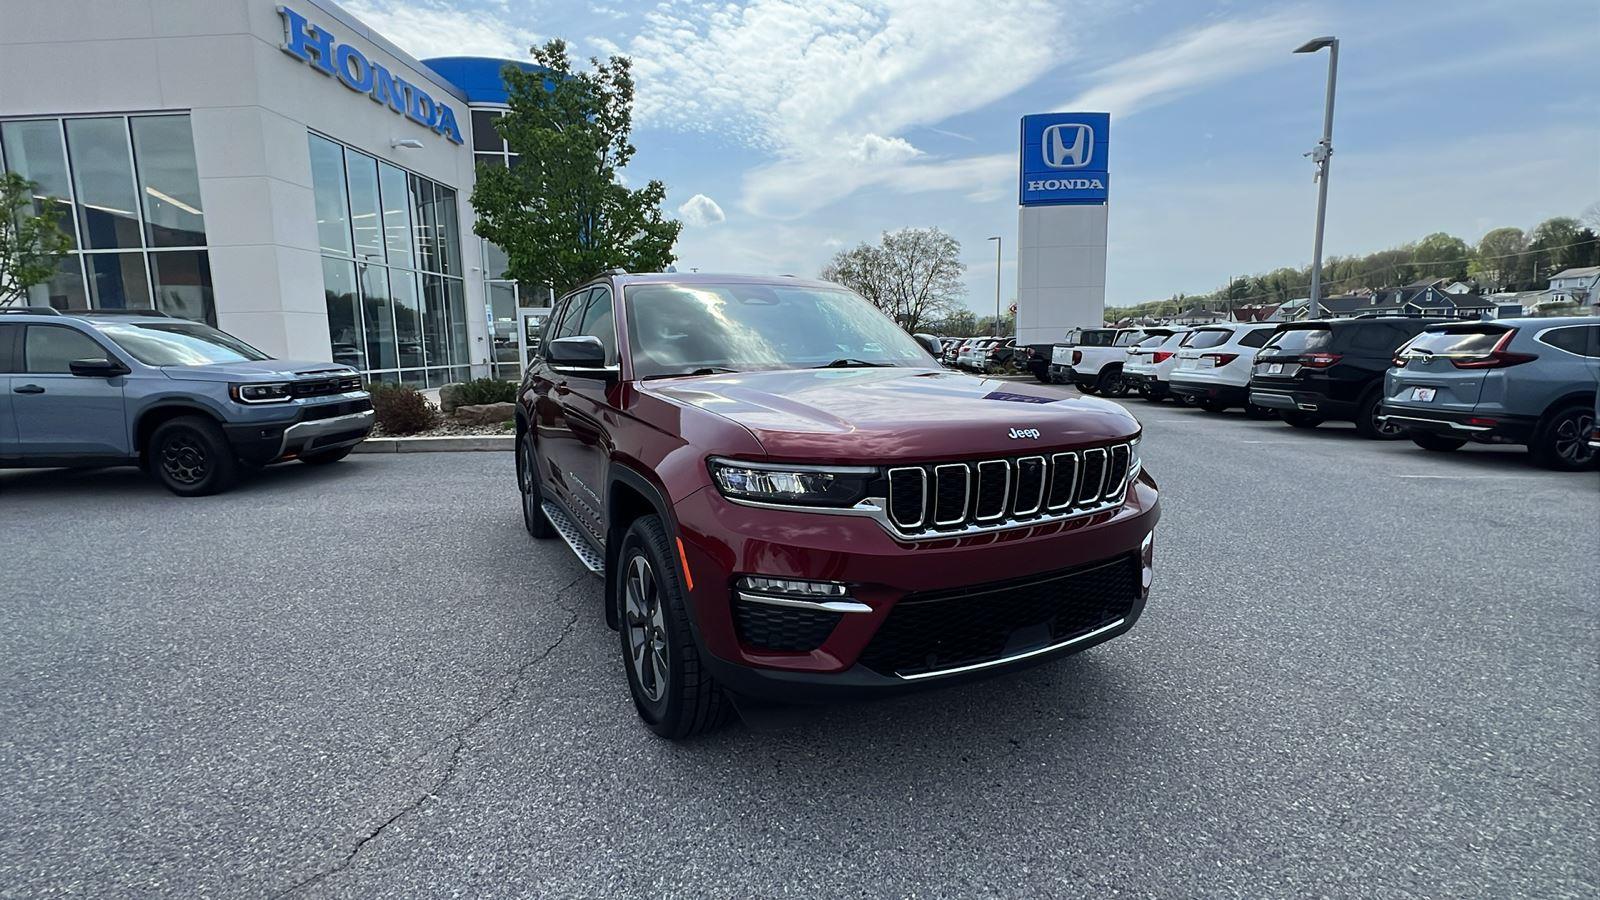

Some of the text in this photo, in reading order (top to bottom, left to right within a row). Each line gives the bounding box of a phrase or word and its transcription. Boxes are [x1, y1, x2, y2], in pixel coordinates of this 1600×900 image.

[277, 6, 464, 145] HONDA
[1028, 179, 1104, 191] HONDA
[1008, 427, 1040, 439] Jeep
